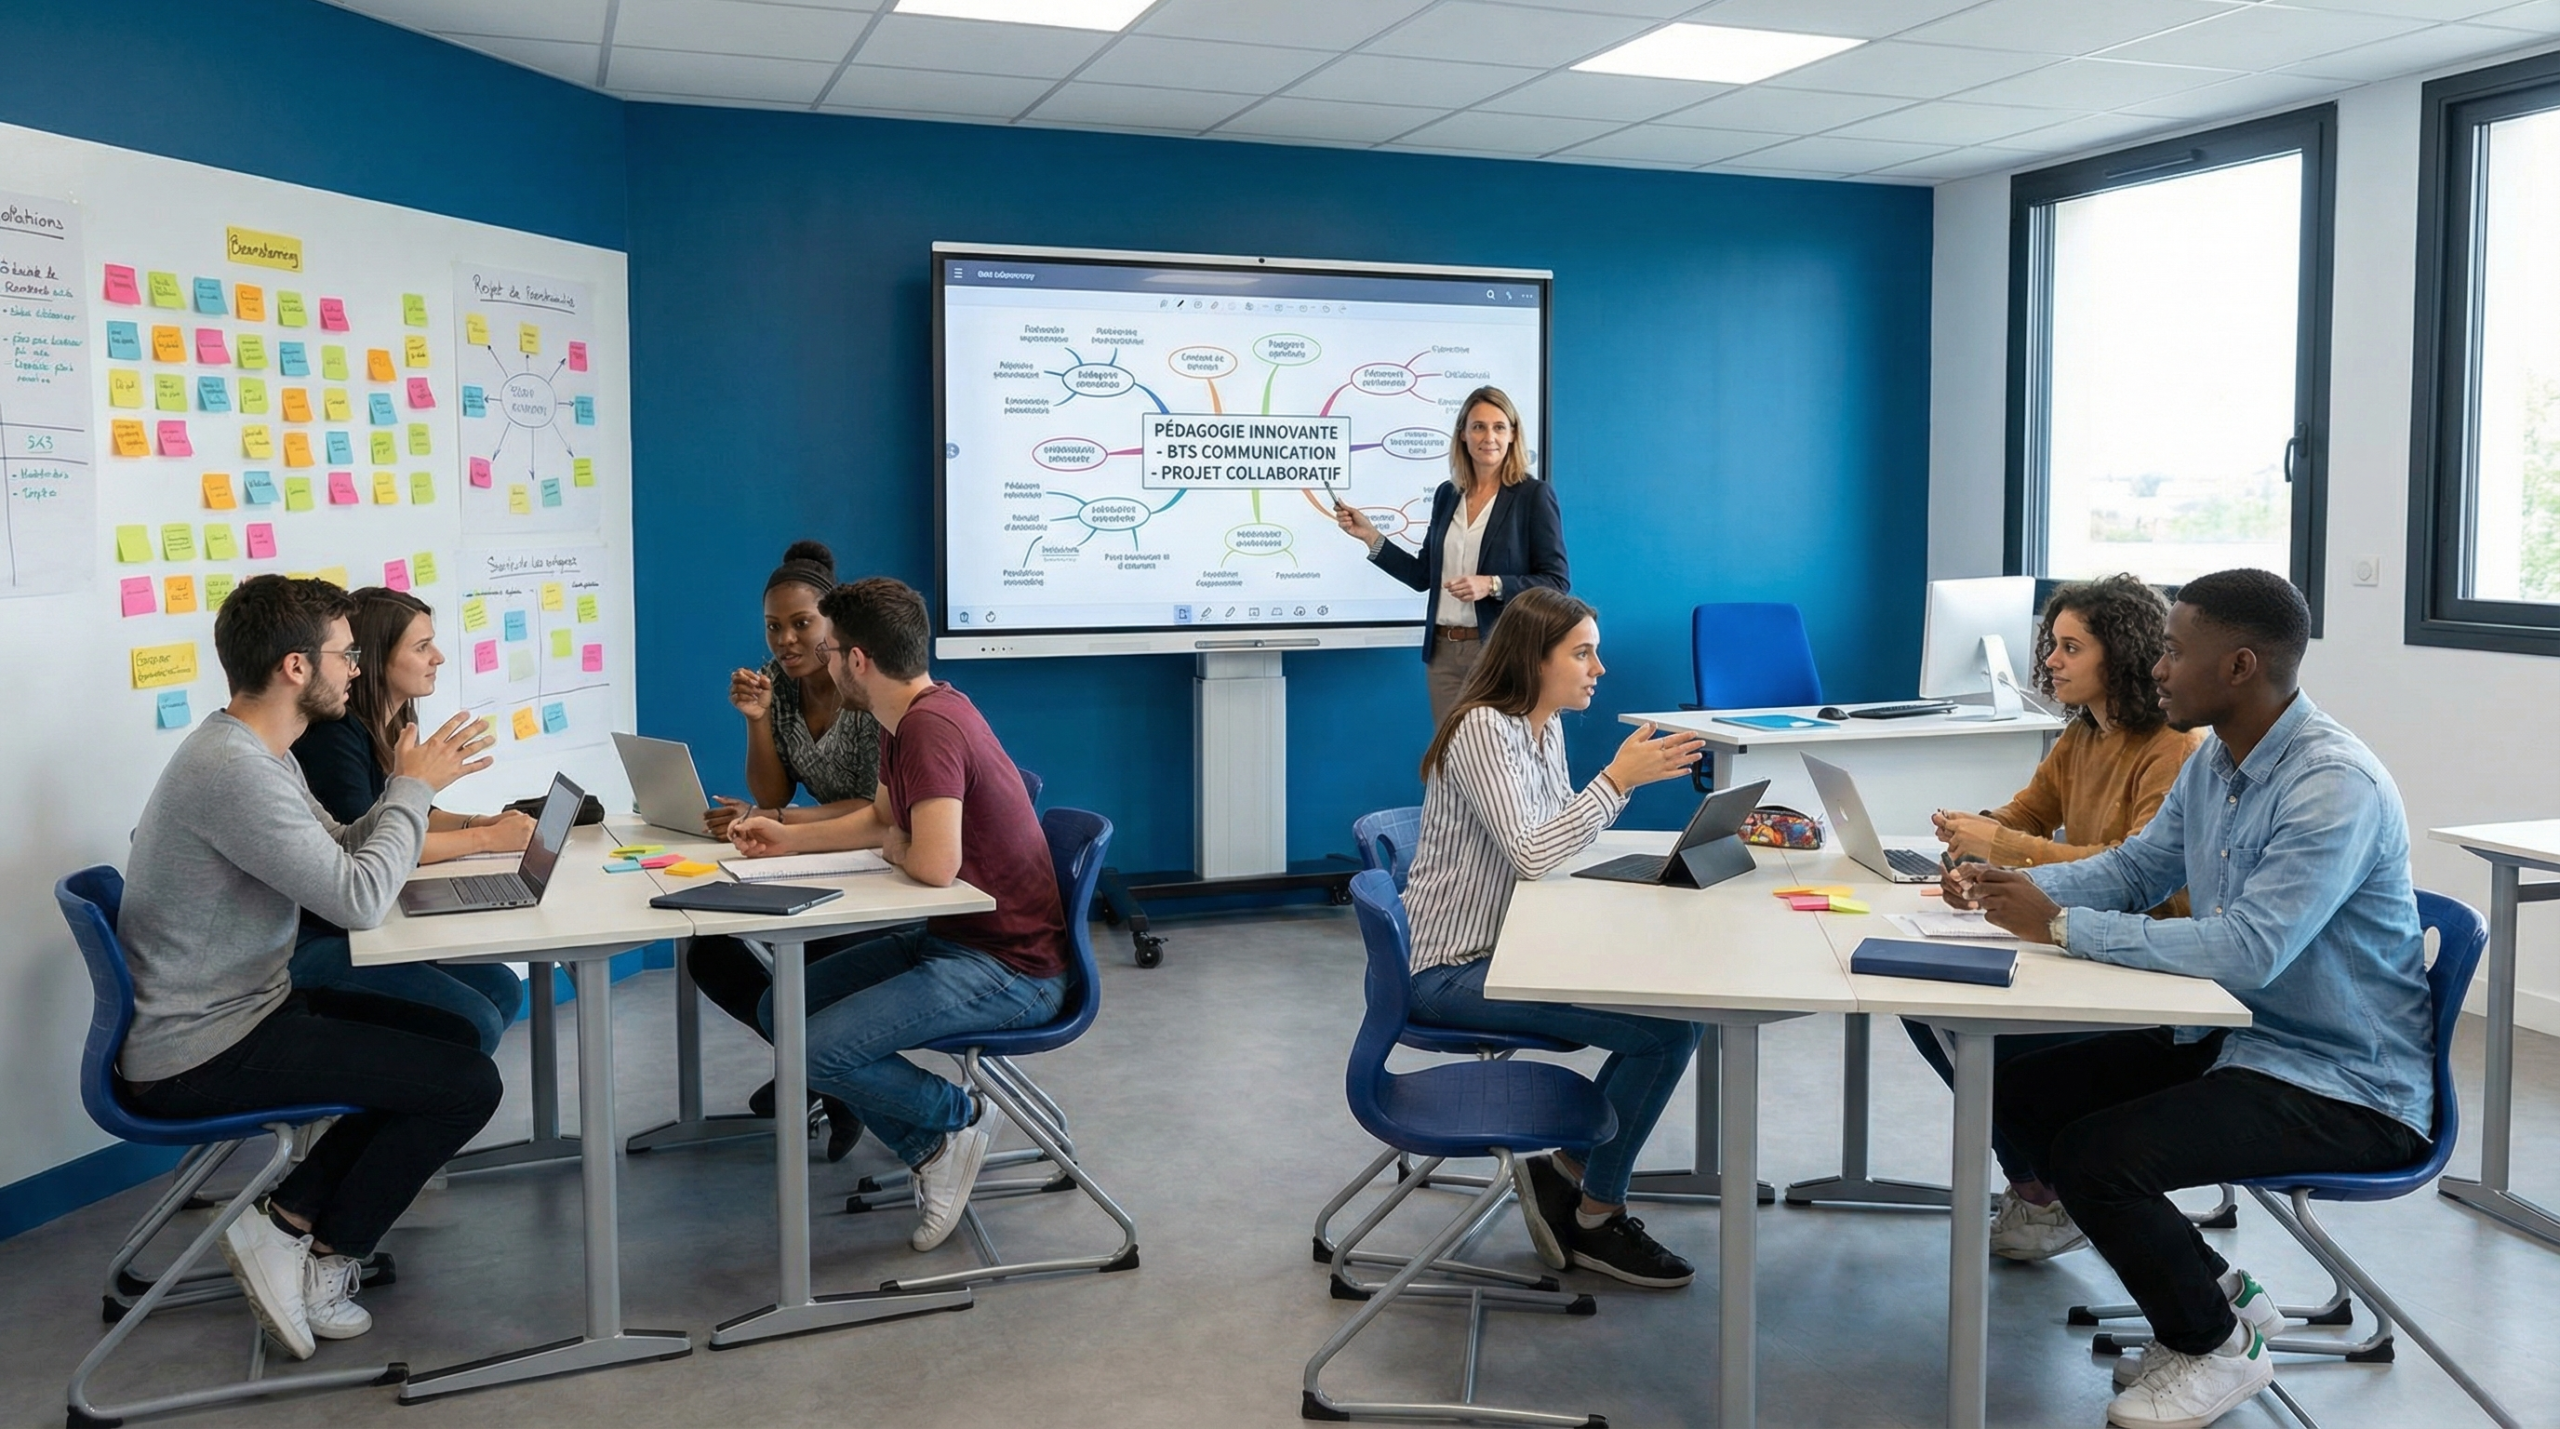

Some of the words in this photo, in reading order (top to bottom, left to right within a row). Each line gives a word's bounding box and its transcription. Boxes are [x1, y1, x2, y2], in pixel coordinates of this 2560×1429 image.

[1155, 419, 1245, 438] PÉDAGOGIE
[1249, 425, 1338, 440] INNOVANTE
[1167, 444, 1198, 459] BTS
[1201, 444, 1336, 460] COMMUNICATION
[1162, 465, 1222, 480] PROJET
[1226, 465, 1341, 481] COLLABORATIF
